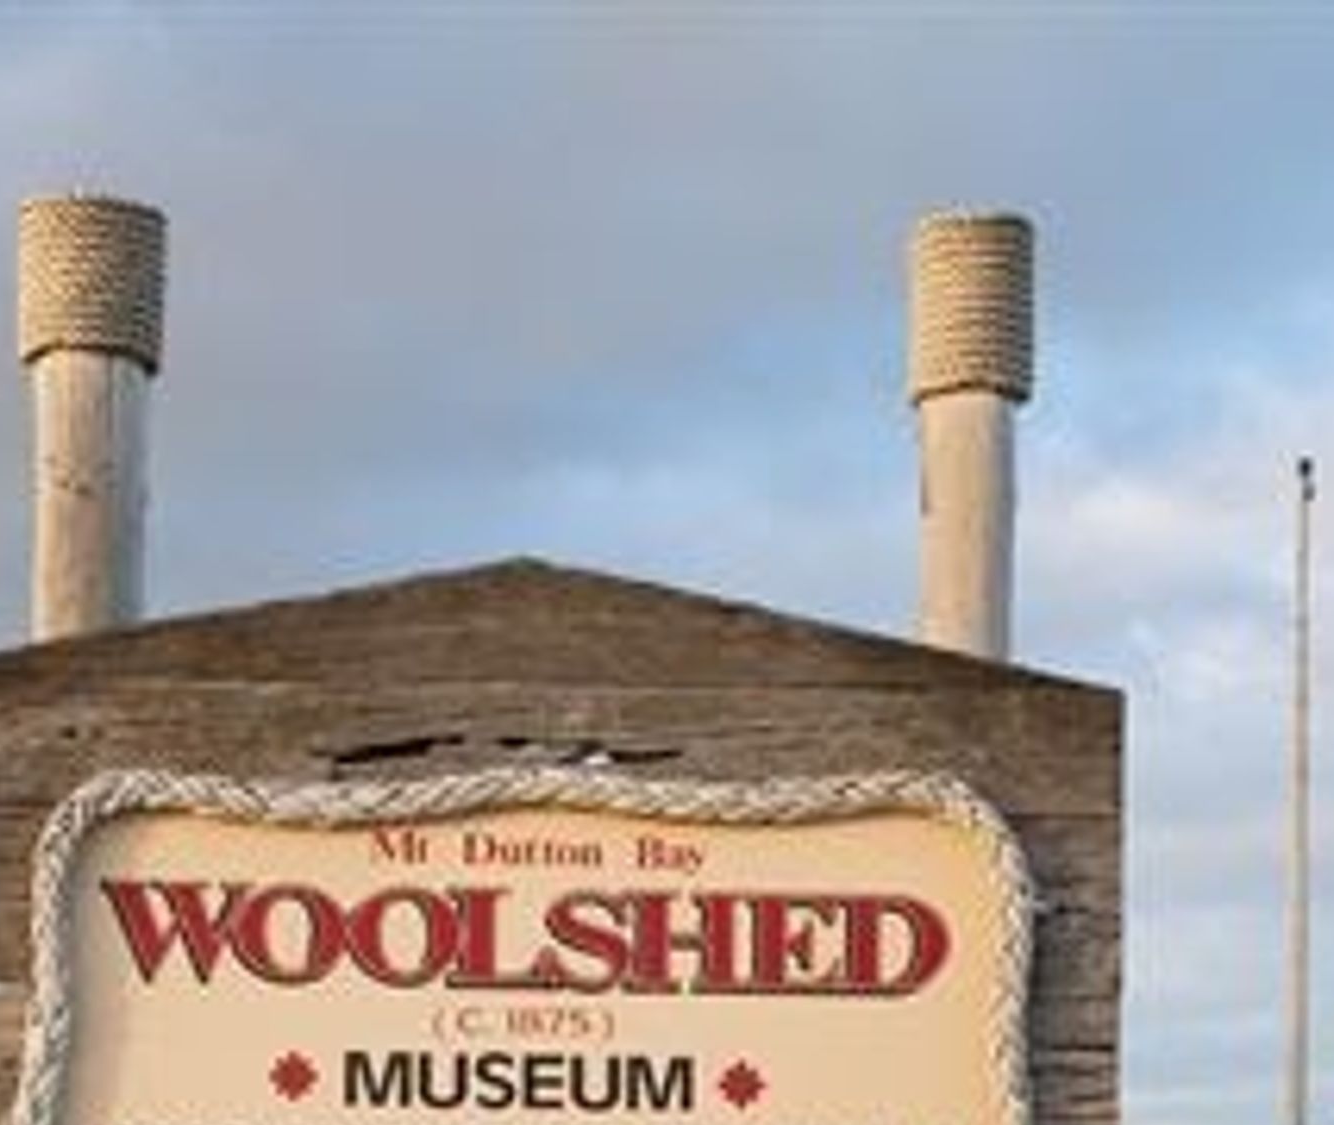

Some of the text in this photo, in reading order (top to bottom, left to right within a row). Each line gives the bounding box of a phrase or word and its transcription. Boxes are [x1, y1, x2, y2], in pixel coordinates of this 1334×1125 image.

[370, 828, 705, 875] Mt Dutton Bay
[101, 879, 951, 998] WOOLSHED
[341, 1050, 695, 1111] MUSEUM
